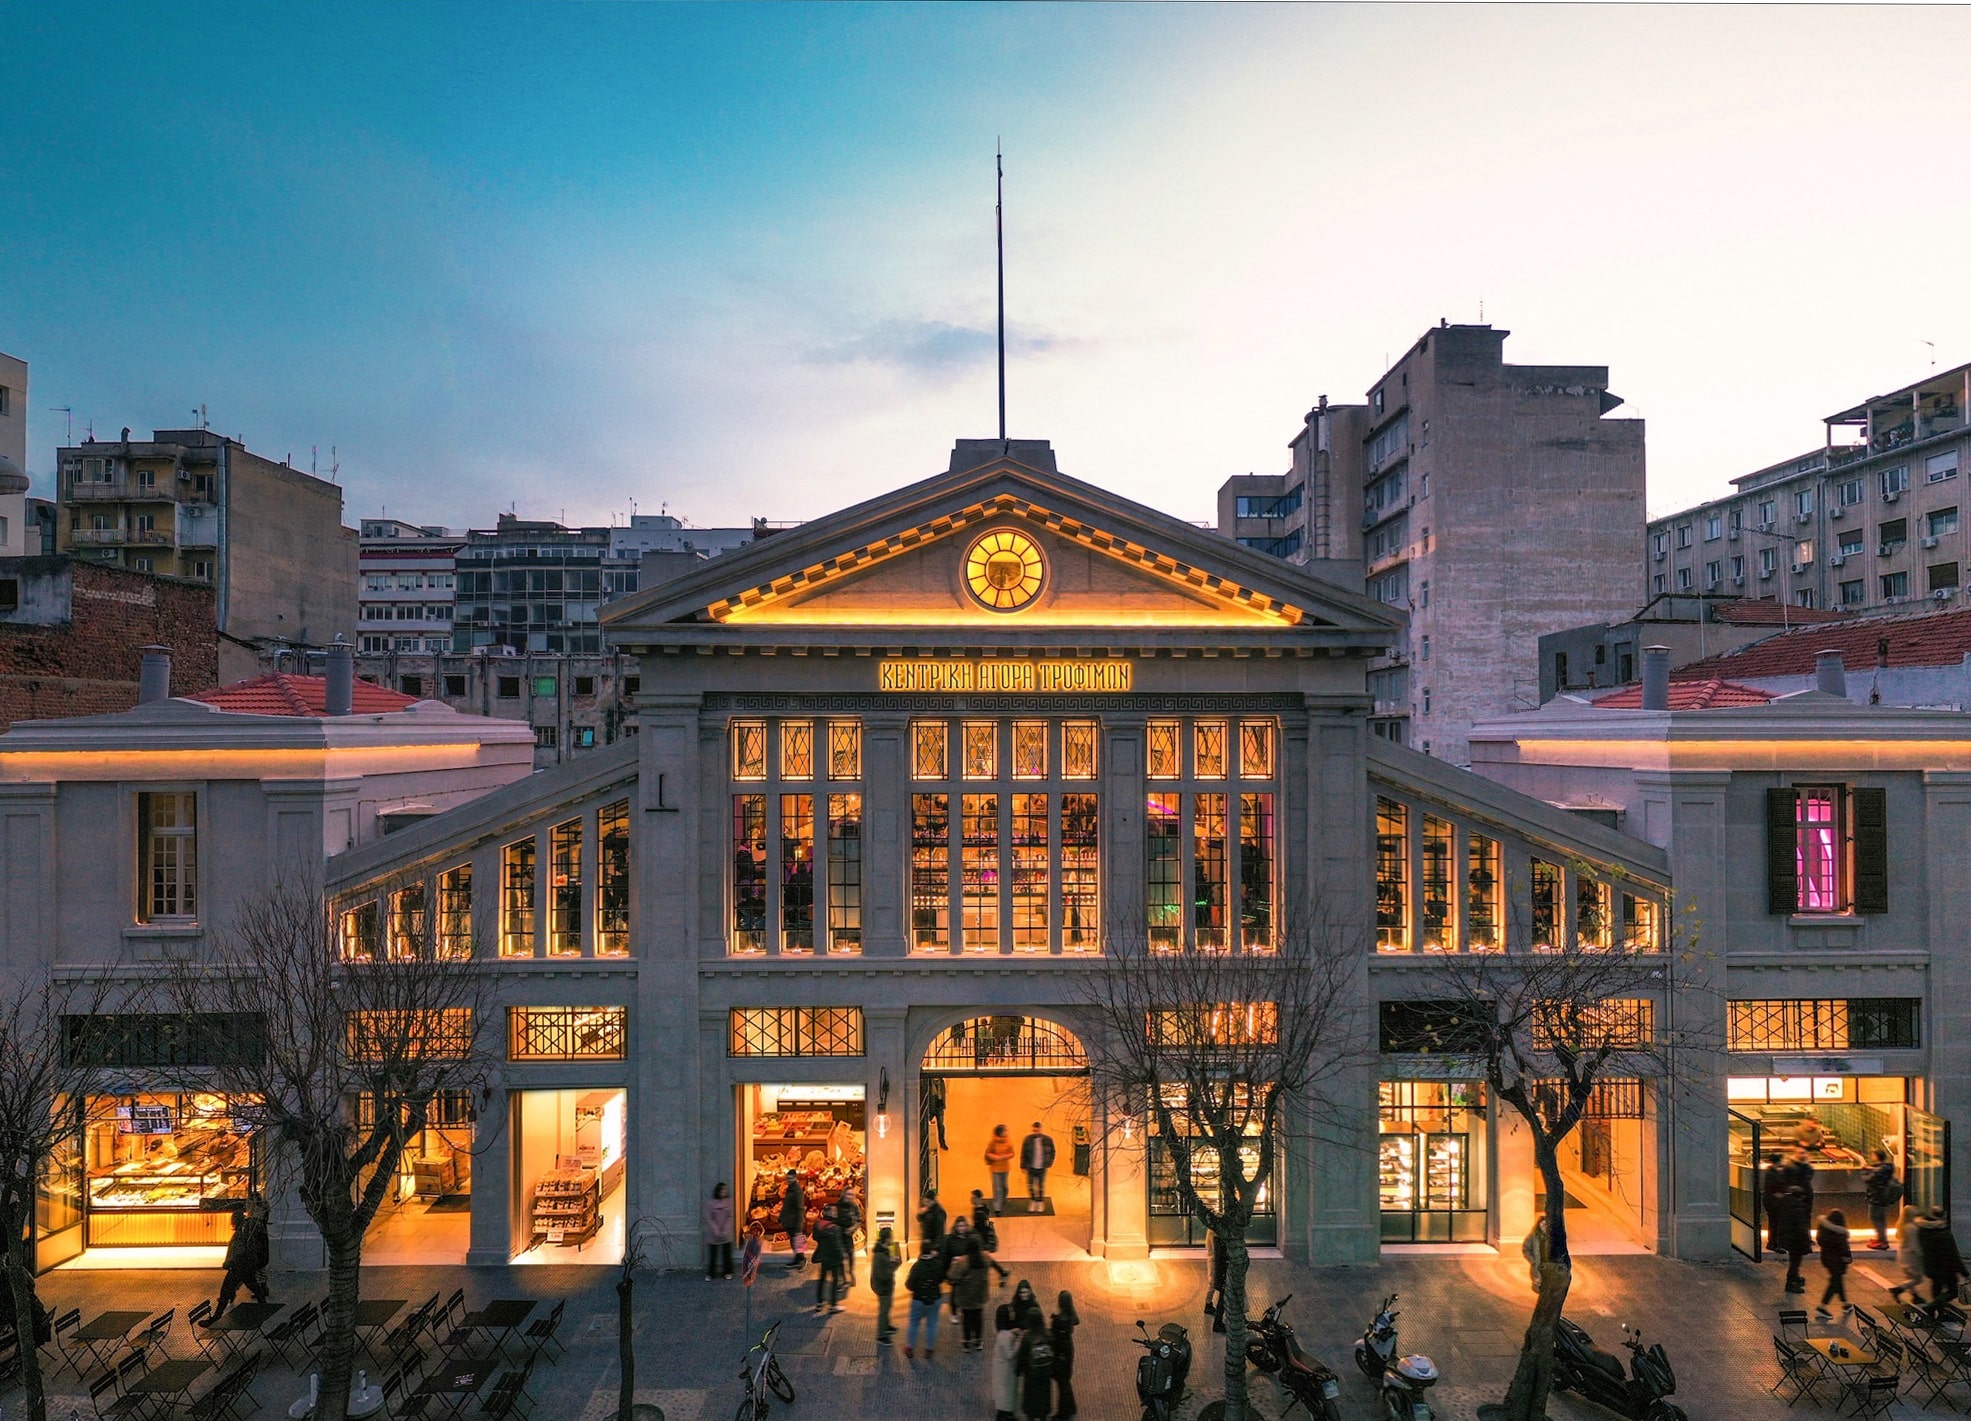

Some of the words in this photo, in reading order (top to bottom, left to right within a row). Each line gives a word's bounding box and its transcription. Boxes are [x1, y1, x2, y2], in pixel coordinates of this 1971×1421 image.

[881, 663, 972, 690] ΚΕΝΤΡΙΚΗ
[978, 663, 1033, 690] ΑΓΟΡΑ
[1039, 663, 1130, 690] ΤΡΟΦΙΜΩΝ
